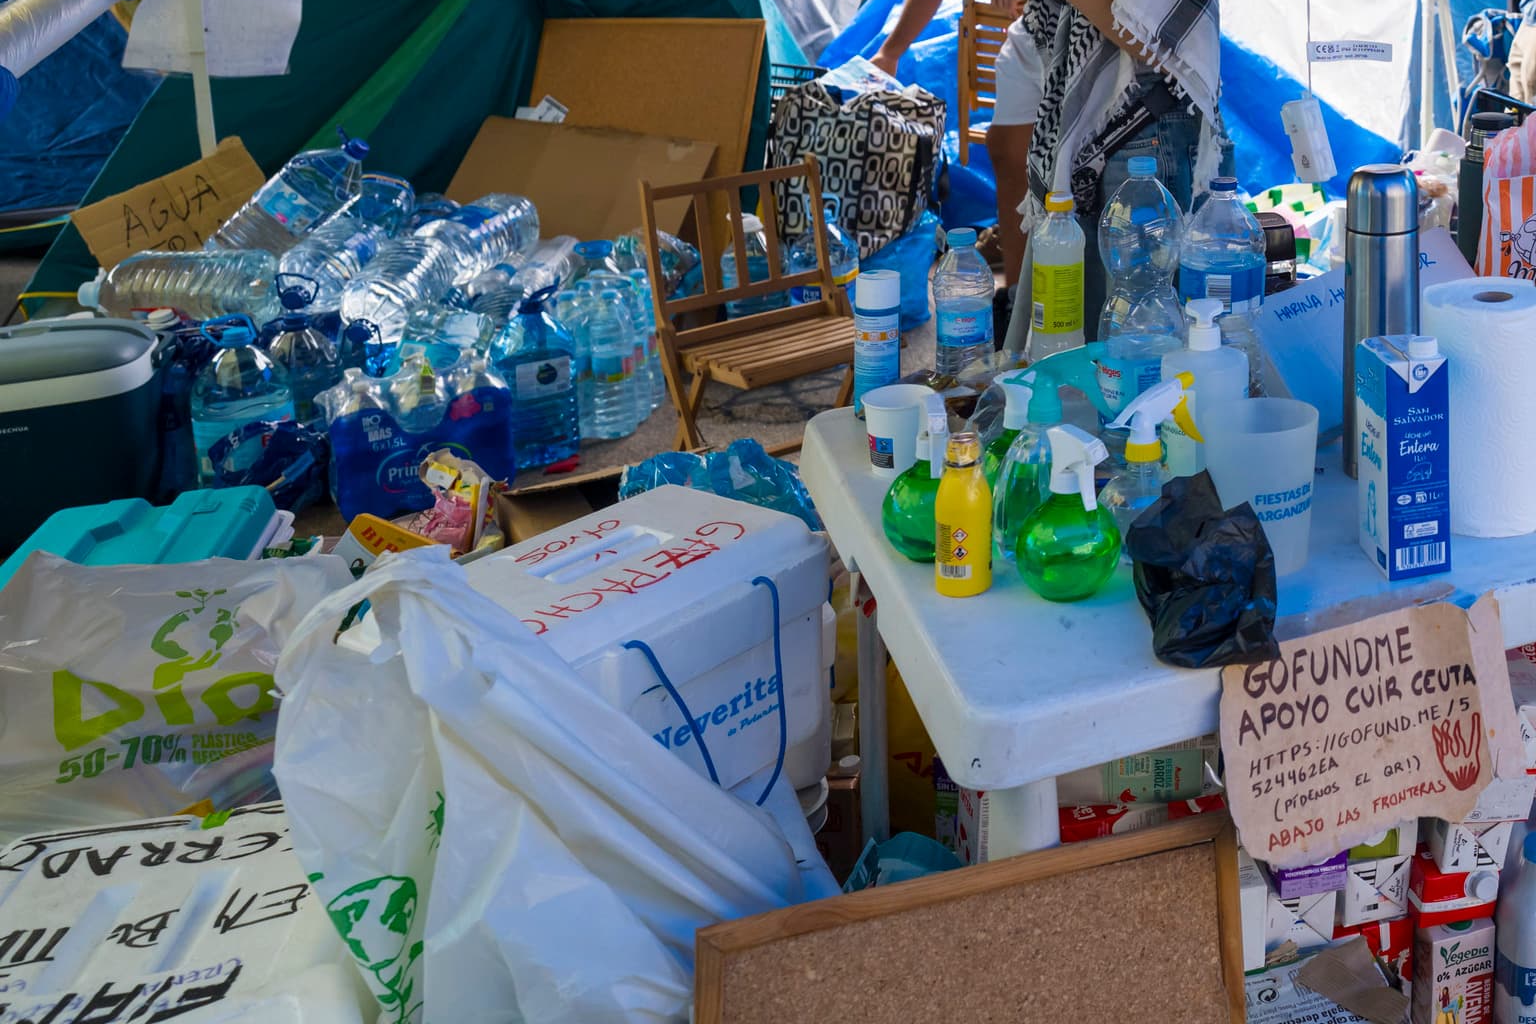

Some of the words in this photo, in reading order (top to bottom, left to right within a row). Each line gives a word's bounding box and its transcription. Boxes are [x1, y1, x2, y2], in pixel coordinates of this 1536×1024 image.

[123, 174, 220, 248] AGUA
[1274, 295, 1323, 321] HARINA
[1400, 439, 1440, 457] Entera
[1255, 487, 1301, 506] FIESTAS
[1243, 626, 1413, 698] GOFUNDME
[1239, 695, 1329, 746] APOYO
[1411, 663, 1477, 696] CEUTA
[55, 733, 187, 785] 50-70%
[1252, 757, 1339, 799] 524462EA
[1355, 773, 1371, 787] EL
[1268, 817, 1325, 852] ABAJO
[1337, 807, 1360, 826] LAS
[1372, 780, 1447, 814] FRONTERAS
[1437, 972, 1450, 983] 0%
[1455, 960, 1492, 977] AZÚCAR
